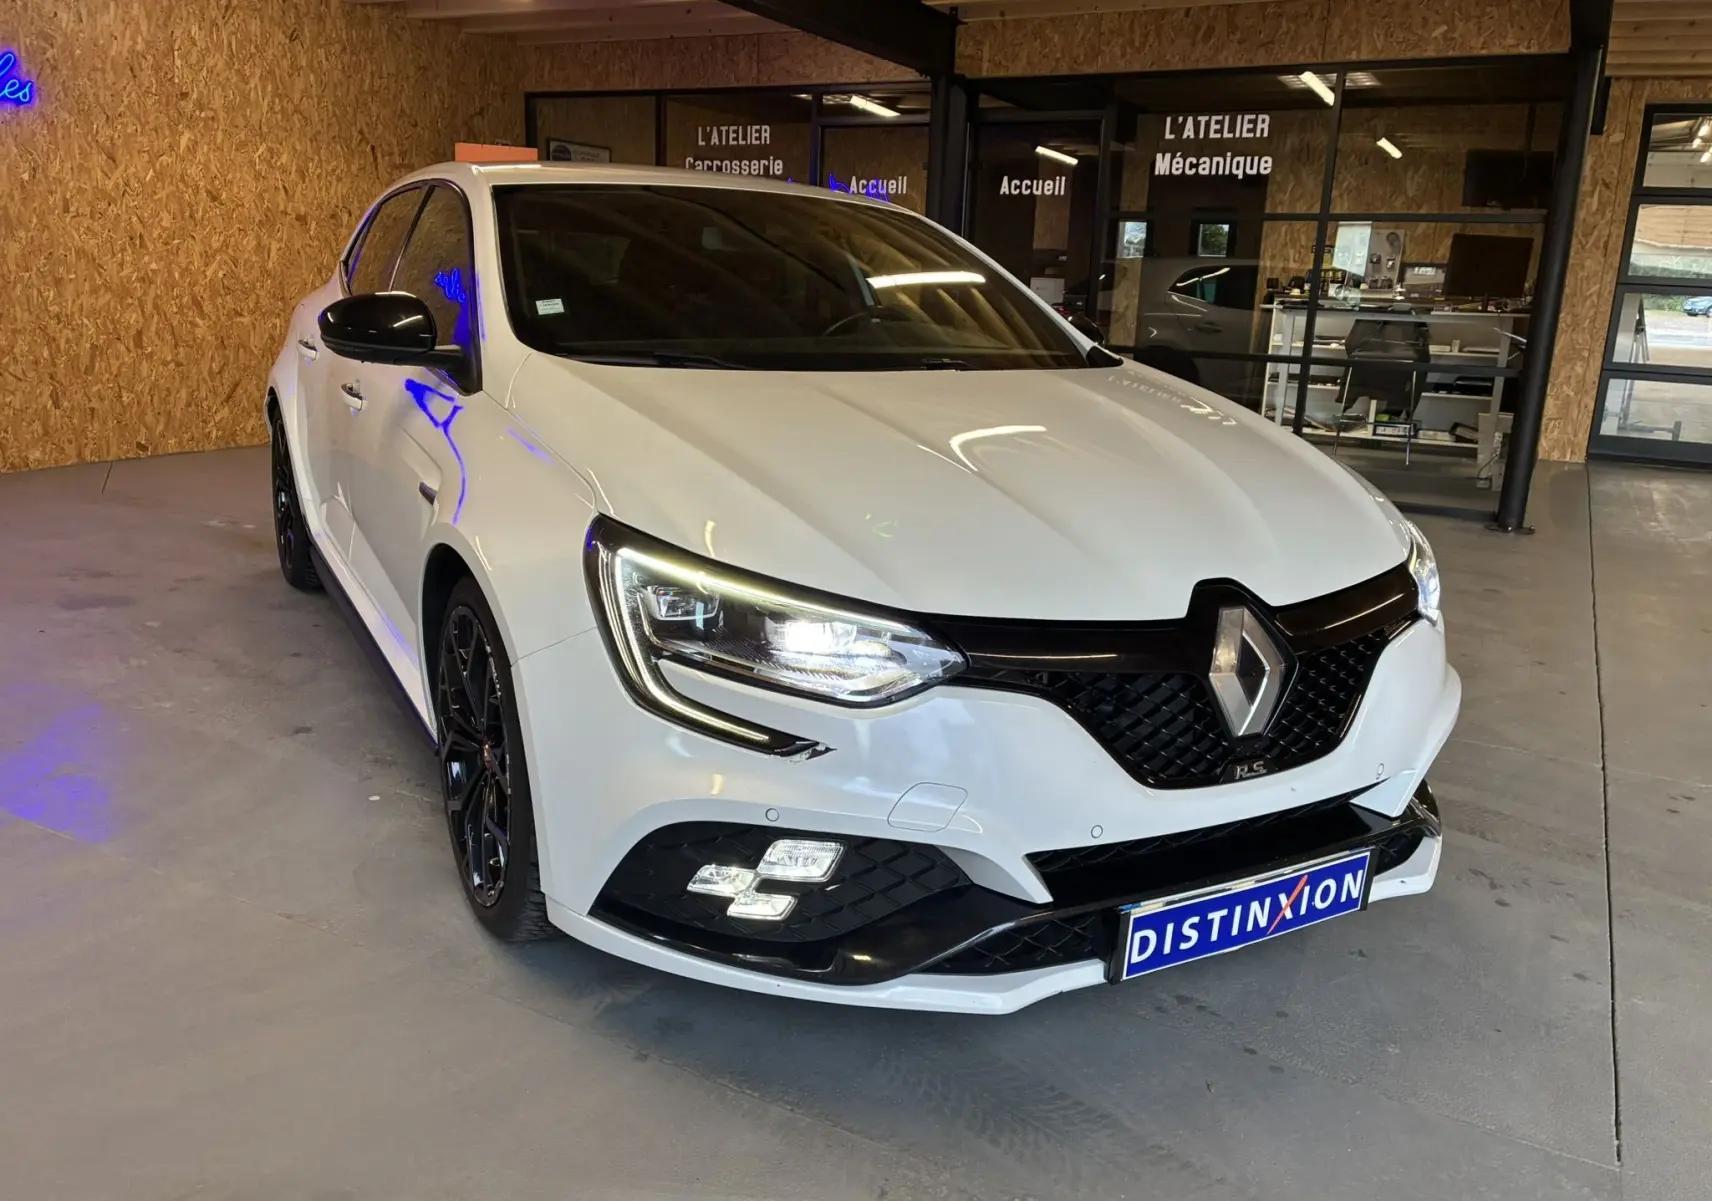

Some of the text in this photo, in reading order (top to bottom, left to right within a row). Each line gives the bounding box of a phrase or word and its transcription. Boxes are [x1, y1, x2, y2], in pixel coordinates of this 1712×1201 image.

[698, 125, 770, 145] L'ATELIER
[1164, 114, 1271, 139] L'ATELIER
[685, 156, 783, 175] Carrosserie
[1154, 152, 1273, 179] Mécanique
[850, 176, 907, 194] Accueil
[1000, 176, 1066, 195] Accueil
[1130, 869, 1363, 964] DISTINXION
